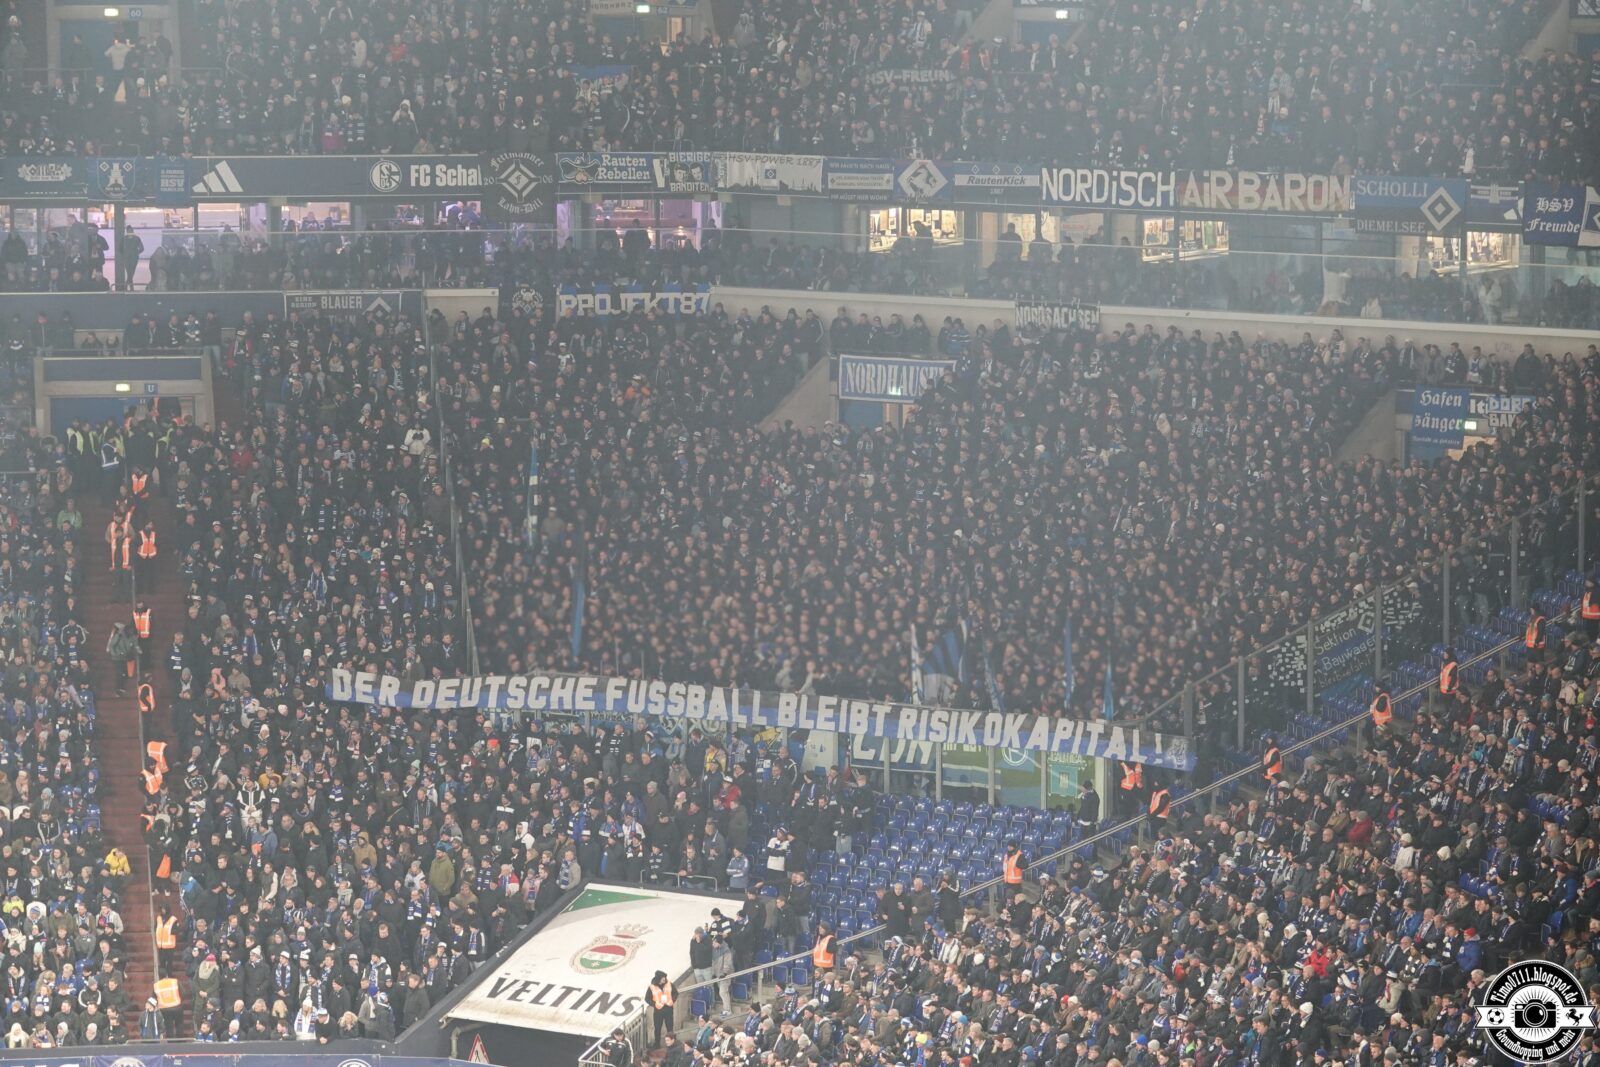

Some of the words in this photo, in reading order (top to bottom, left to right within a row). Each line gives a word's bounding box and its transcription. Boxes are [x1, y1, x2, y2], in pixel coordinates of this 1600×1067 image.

[601, 154, 646, 167] Rauten
[410, 164, 431, 187] FC
[597, 167, 650, 180] Rebellen
[966, 175, 1026, 186] RautenKick
[1356, 179, 1428, 198] SCHOLLI
[1536, 196, 1574, 213] HSV
[1357, 218, 1426, 233] DIEMELSEE
[1525, 217, 1580, 232] Freunde
[320, 295, 363, 309] BLAUER
[148, 384, 155, 393] U
[1419, 390, 1463, 409] Hafen
[1314, 627, 1357, 656] Sektion
[332, 668, 401, 708] DER
[411, 675, 598, 711] DEUTSCHE
[605, 678, 769, 727] FUSSBALL
[777, 692, 893, 738] BLEIBT
[486, 976, 644, 1018] VELTINS
